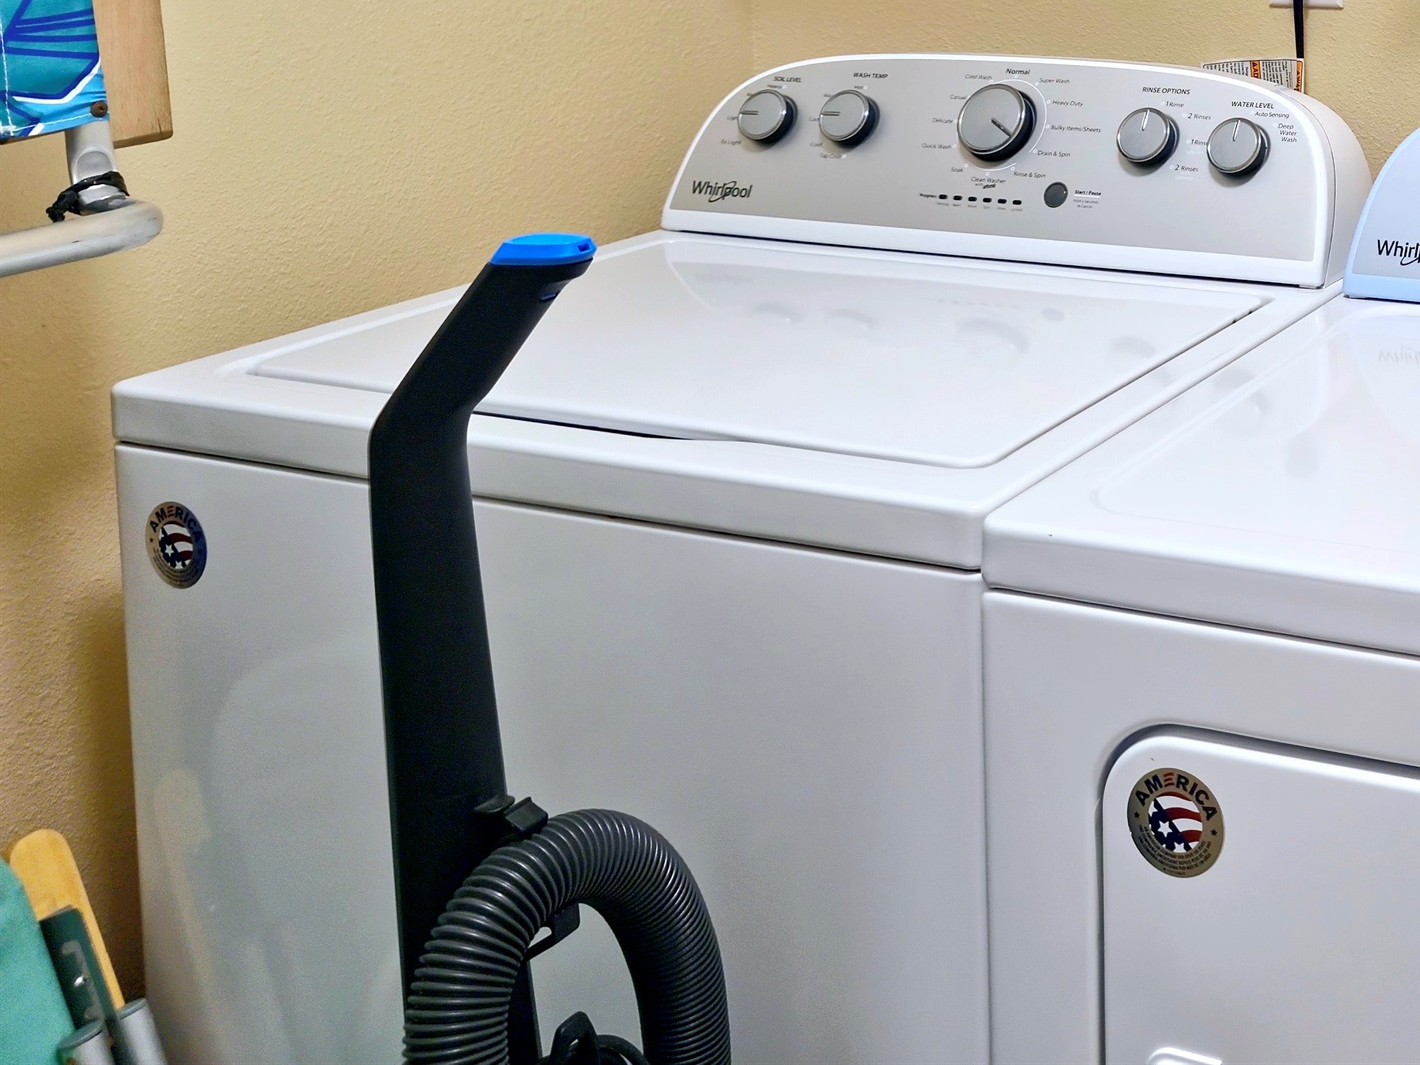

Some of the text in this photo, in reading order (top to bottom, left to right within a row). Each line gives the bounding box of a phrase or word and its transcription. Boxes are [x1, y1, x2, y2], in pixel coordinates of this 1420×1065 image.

[1162, 88, 1190, 96] OPTIONS
[1066, 126, 1102, 134] Items/Sheets
[692, 180, 753, 203] Whirlpool
[1135, 772, 1218, 821] AMERICA
